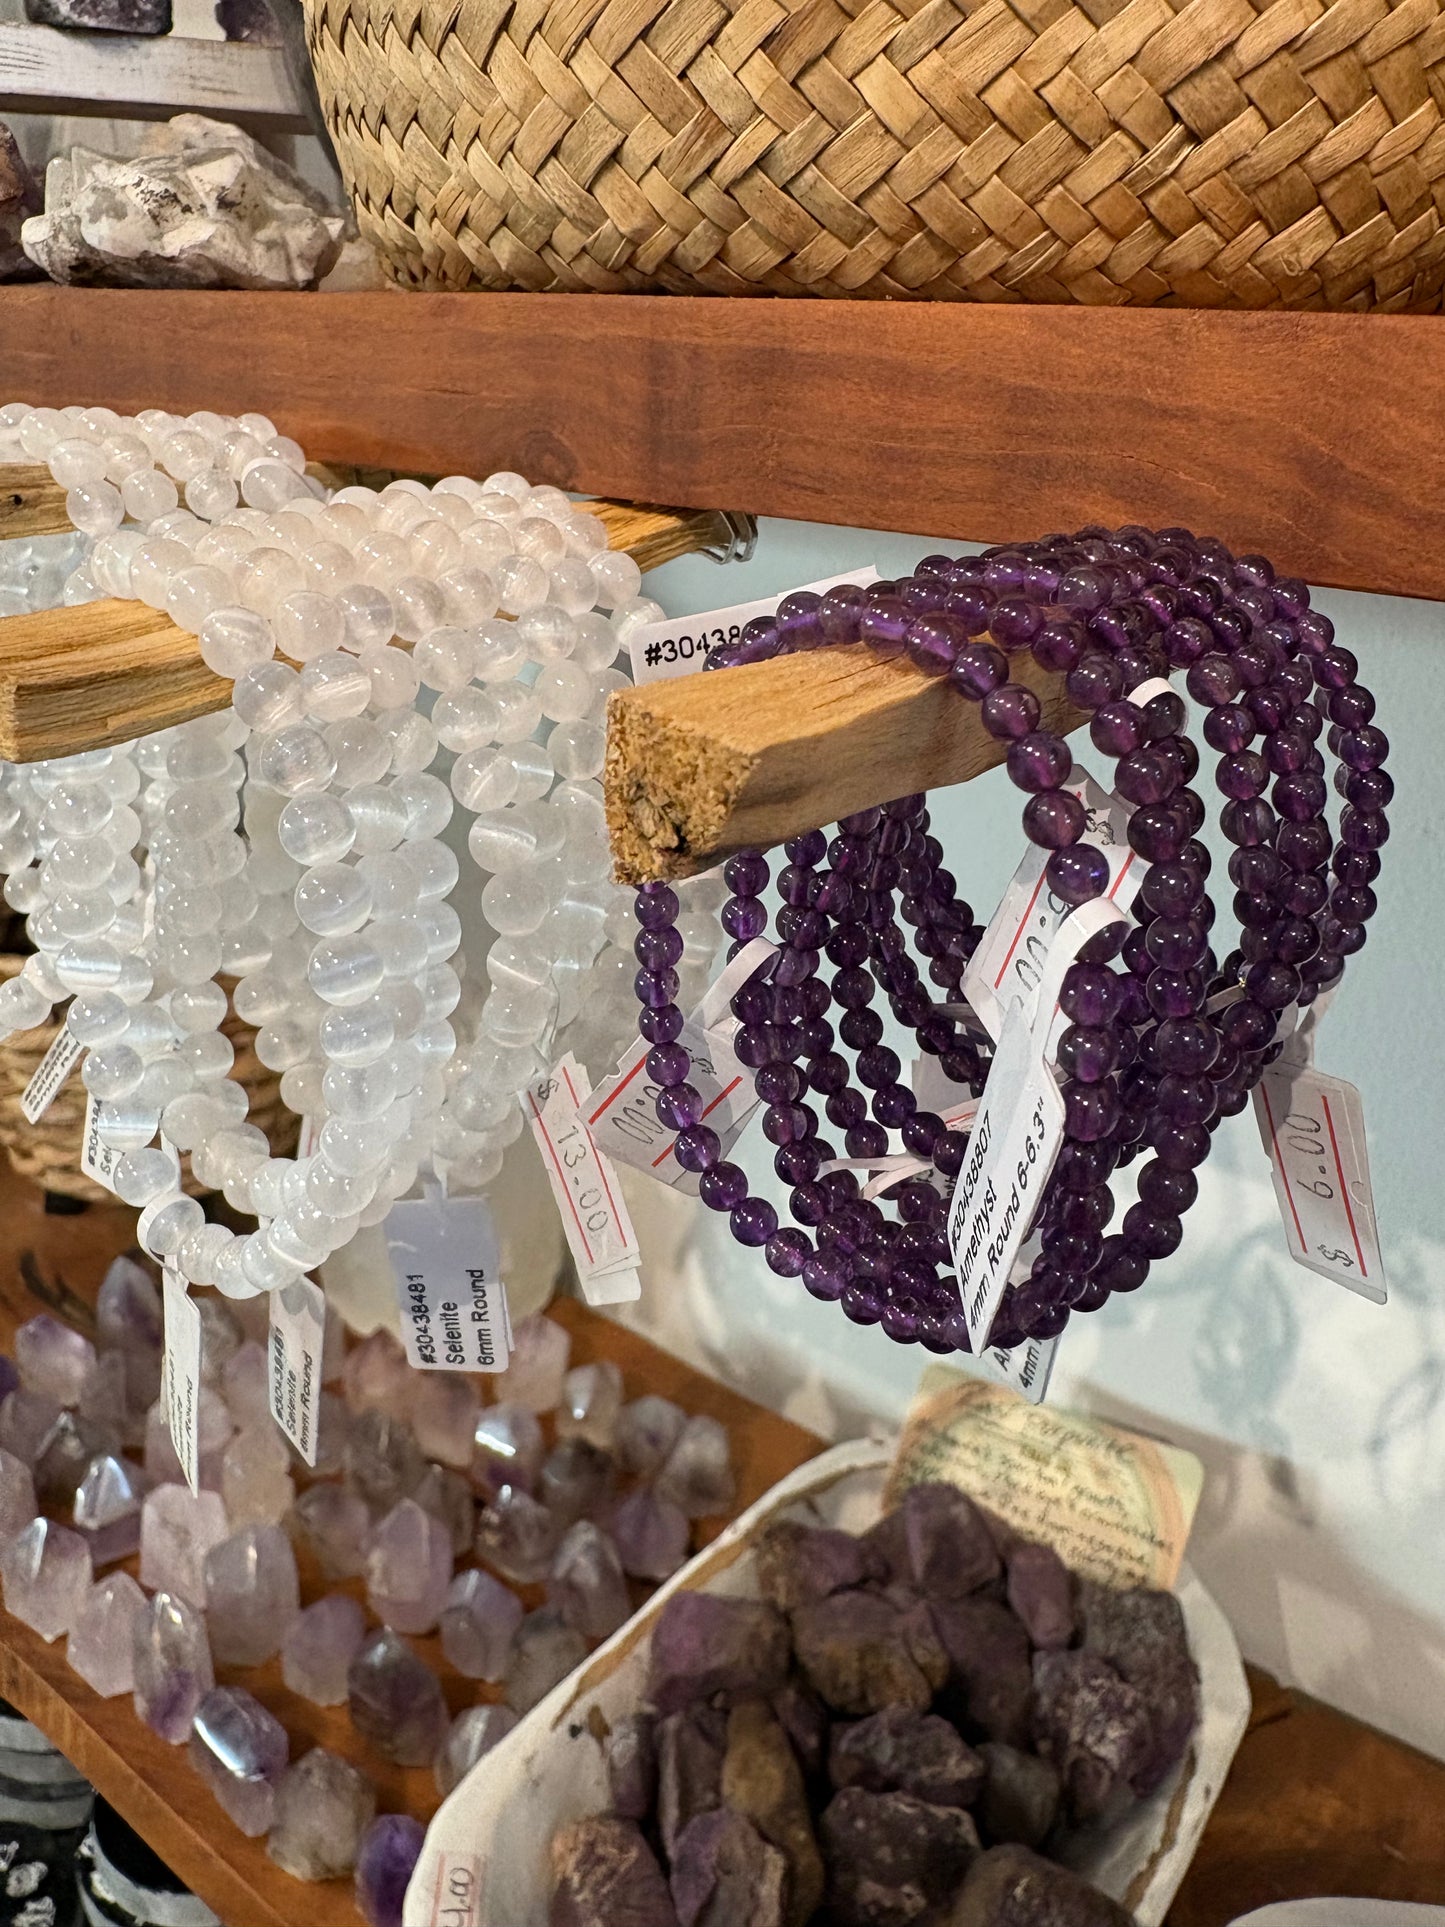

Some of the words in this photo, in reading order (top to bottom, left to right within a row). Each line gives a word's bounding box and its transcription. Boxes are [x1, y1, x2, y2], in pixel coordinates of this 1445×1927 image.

[558, 1125, 608, 1231] 13.00
[952, 1109, 991, 1256] #30438807
[1284, 1114, 1333, 1198] 6.00
[959, 1176, 997, 1297] Amethyst
[970, 1273, 991, 1329] 4mm
[987, 1182, 1020, 1277] Round
[1017, 1096, 1044, 1190] 6-6.3"
[406, 1274, 438, 1364] #30438481
[440, 1301, 465, 1364] Selenite
[465, 1269, 490, 1322] Round
[300, 1350, 312, 1410] Round
[477, 1328, 495, 1365] 6mm
[1019, 1346, 1040, 1389] 4mm
